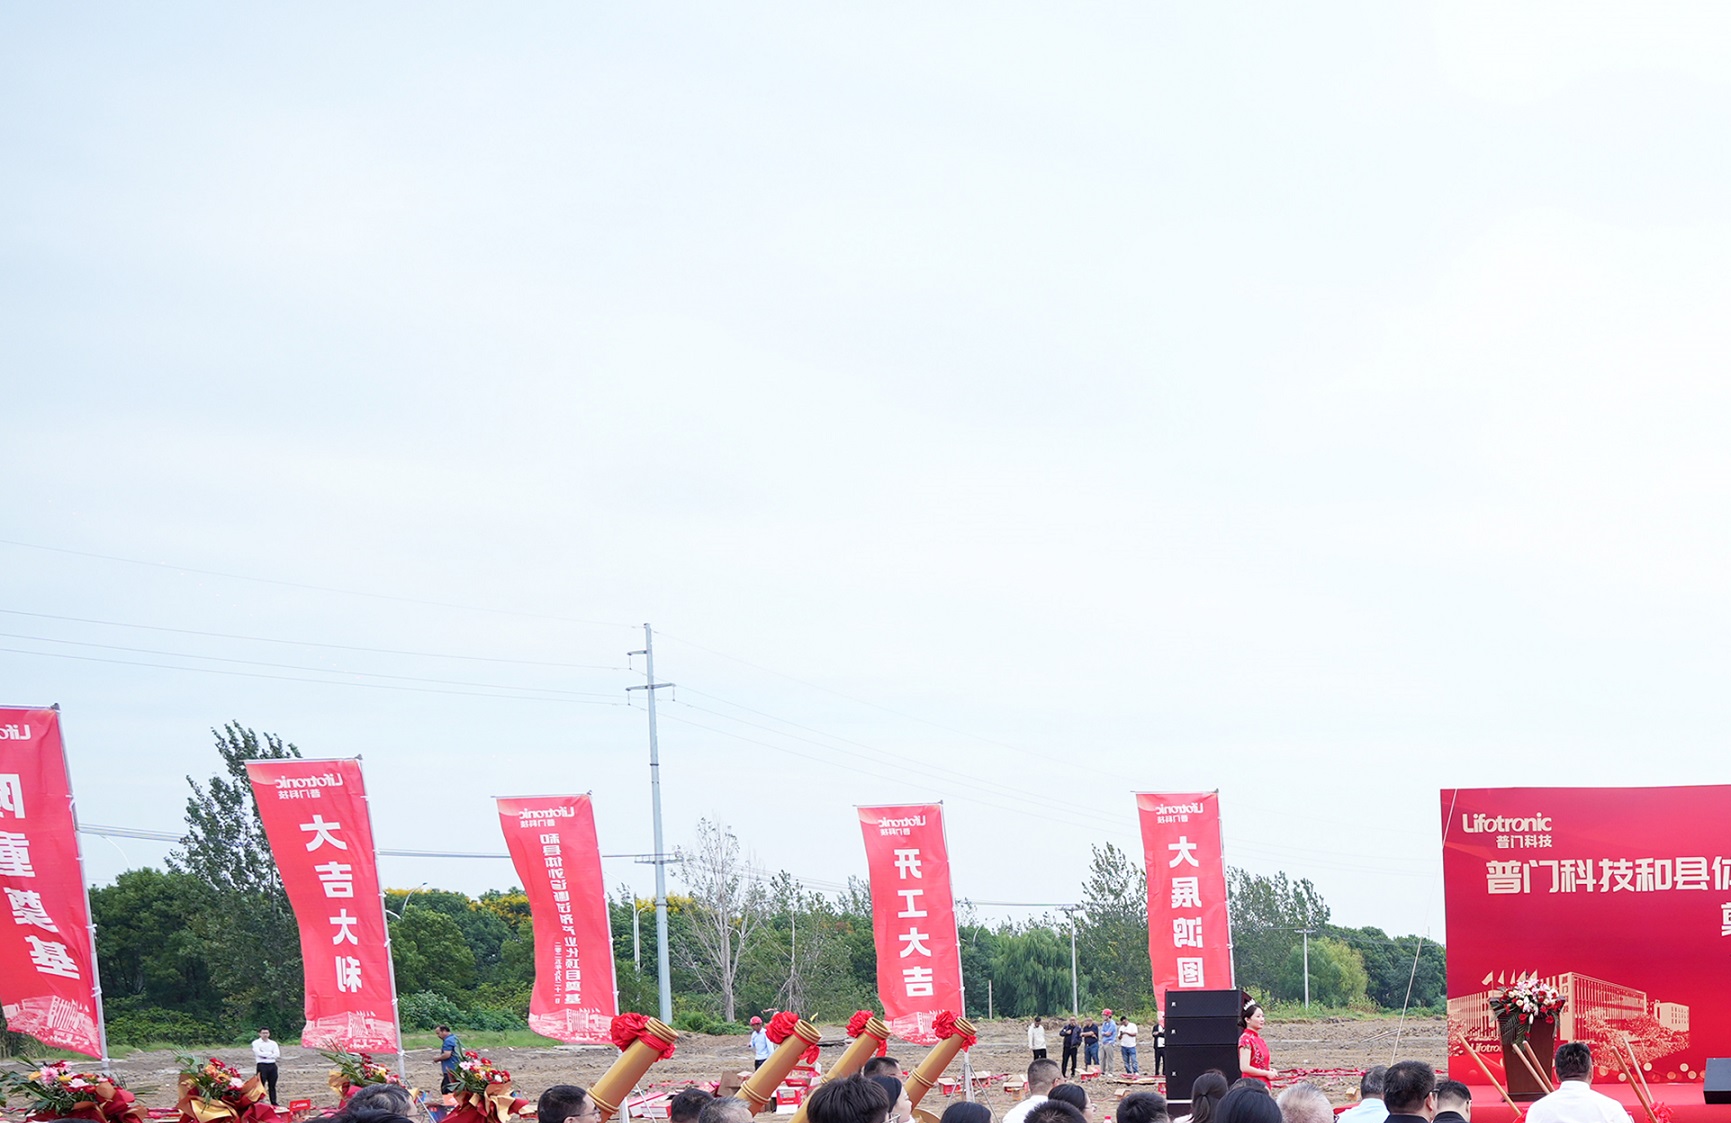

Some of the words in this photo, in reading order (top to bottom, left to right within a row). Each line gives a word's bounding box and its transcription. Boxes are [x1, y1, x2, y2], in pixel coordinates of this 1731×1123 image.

[1462, 812, 1552, 833] Lifotronic
[1496, 834, 1552, 849] 普门科技
[1470, 1042, 1501, 1053] Lifotro
